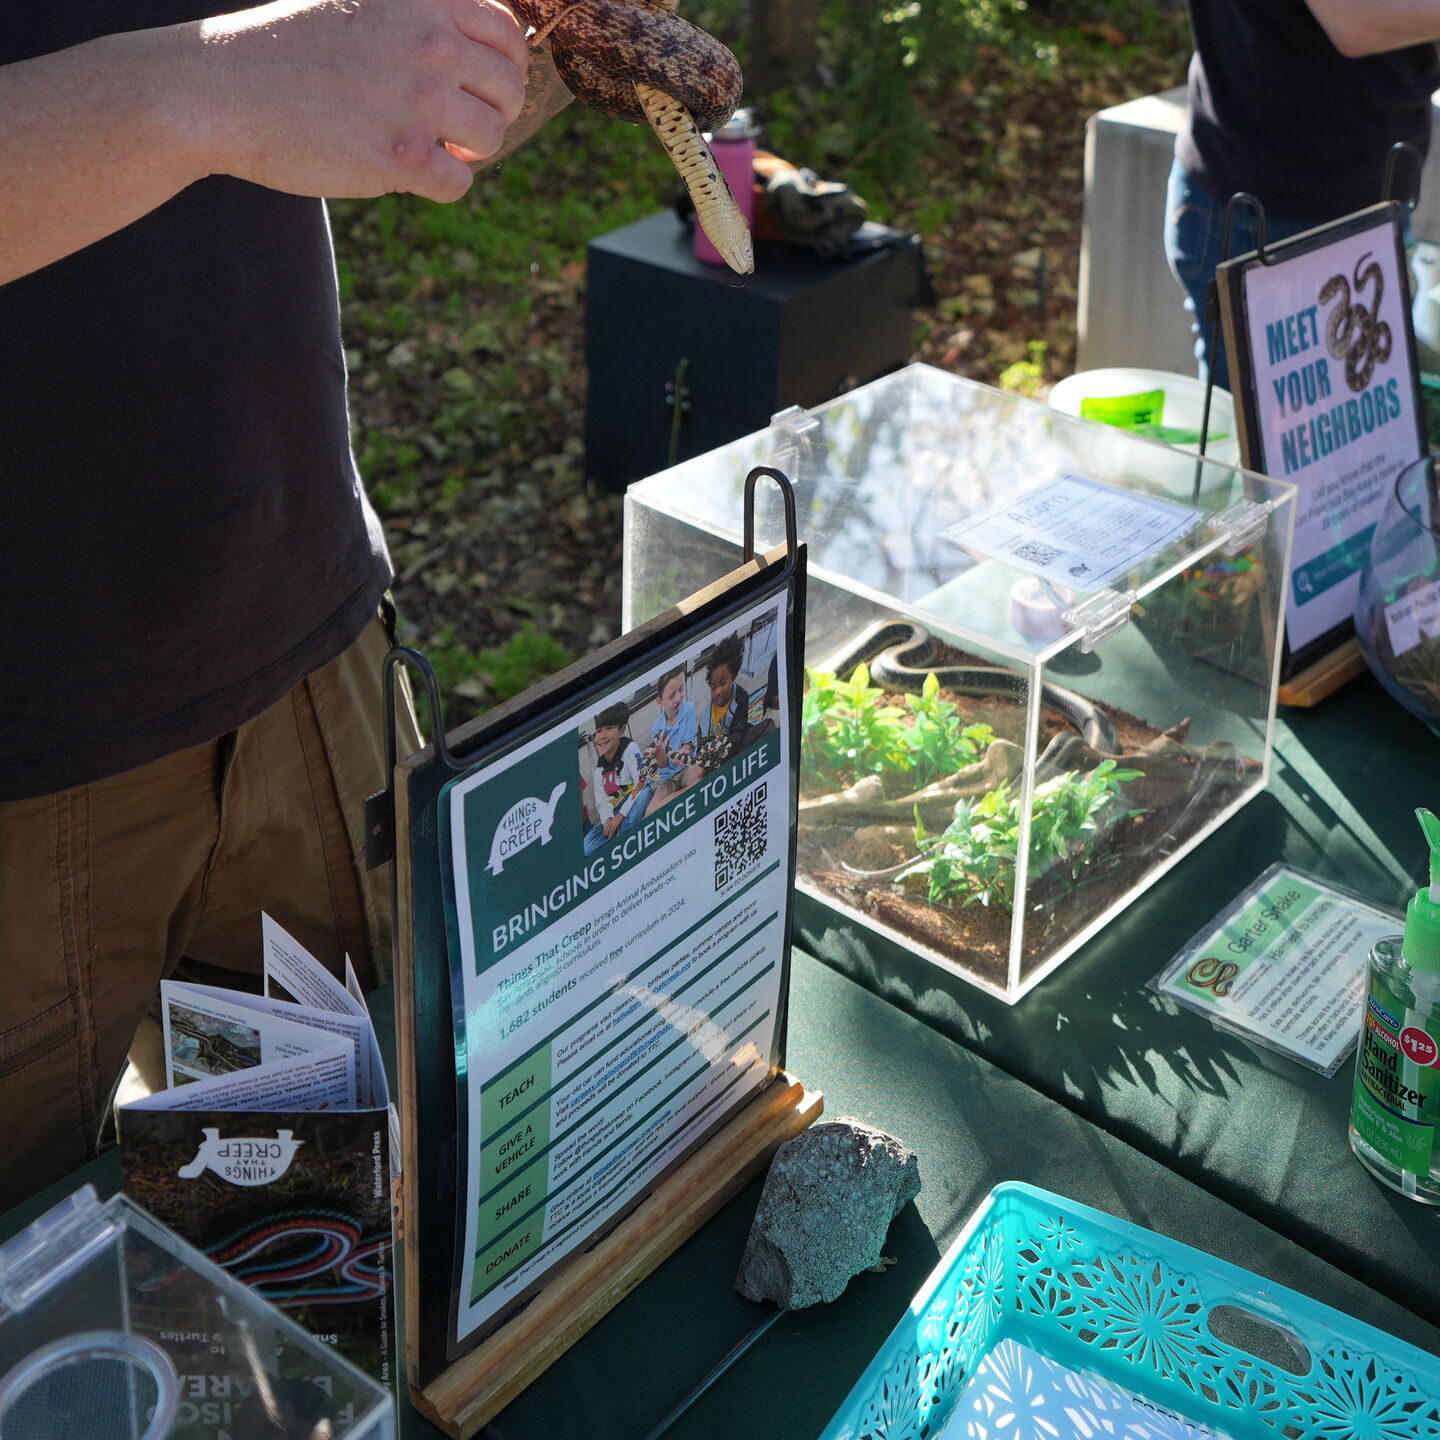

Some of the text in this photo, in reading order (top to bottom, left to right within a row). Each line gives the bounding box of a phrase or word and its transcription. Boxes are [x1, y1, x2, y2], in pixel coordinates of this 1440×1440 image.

[1266, 305, 1320, 365] MEET
[1273, 359, 1331, 418] YOUR
[1281, 378, 1402, 476] NEIGHBORS
[499, 817, 542, 857] CREEP
[501, 797, 536, 831] THINGS
[509, 816, 530, 834] THAT
[492, 742, 769, 952] BRINGING SCIENCE TO LIFE
[720, 861, 761, 898] SCAN TO DONATE
[534, 942, 558, 968] That
[561, 918, 591, 953] Creep
[593, 904, 614, 928] brings
[615, 887, 639, 910] Animal
[640, 856, 682, 893] Ambassadors
[683, 845, 696, 862] into
[591, 919, 610, 939] order
[611, 911, 619, 925] to
[620, 895, 643, 918] deliver
[1225, 888, 1302, 953] Garter Snake
[499, 1009, 530, 1041] 1,682
[532, 975, 577, 1016] students
[579, 955, 607, 982] received
[608, 942, 623, 962] free
[624, 917, 659, 948] curriculum
[660, 910, 666, 922] in
[667, 896, 686, 916] 2024.
[556, 1042, 568, 1059] Our
[569, 1021, 598, 1049] programs
[599, 1009, 611, 1026] visit
[647, 966, 670, 990] birthday
[691, 933, 713, 954] summer
[714, 918, 732, 938] camps
[732, 908, 743, 923] and
[556, 1047, 577, 1068] Please
[578, 1032, 595, 1052] email
[604, 1021, 611, 1032] at
[691, 953, 697, 965] to
[698, 942, 711, 959] book
[716, 922, 738, 945] program
[739, 912, 750, 927] with
[555, 1101, 569, 1118] Visit
[719, 972, 730, 987] free
[730, 958, 748, 977] vehicle
[1364, 1026, 1399, 1073] Hand
[1375, 1026, 1400, 1051] ALCOHOL
[555, 1027, 652, 1108] Your old car can fund educational
[555, 1049, 647, 1129] and proceeds will be donated to
[1362, 1048, 1427, 1109] Sanitizer
[498, 1074, 534, 1110] TEACH
[216, 1142, 281, 1158] CREEP
[495, 1136, 535, 1175] VEHICLE
[498, 1121, 532, 1157] GIVE A
[552, 1124, 614, 1182] work with friends and
[552, 1151, 573, 1172] Follow
[553, 1139, 576, 1162] Spread
[576, 1129, 587, 1144] the
[224, 1165, 276, 1180] THINGS
[371, 1129, 382, 1198] Waterford Press
[494, 1183, 531, 1221] SHARE
[550, 1196, 564, 1215] Give
[485, 1230, 532, 1275] DONATE
